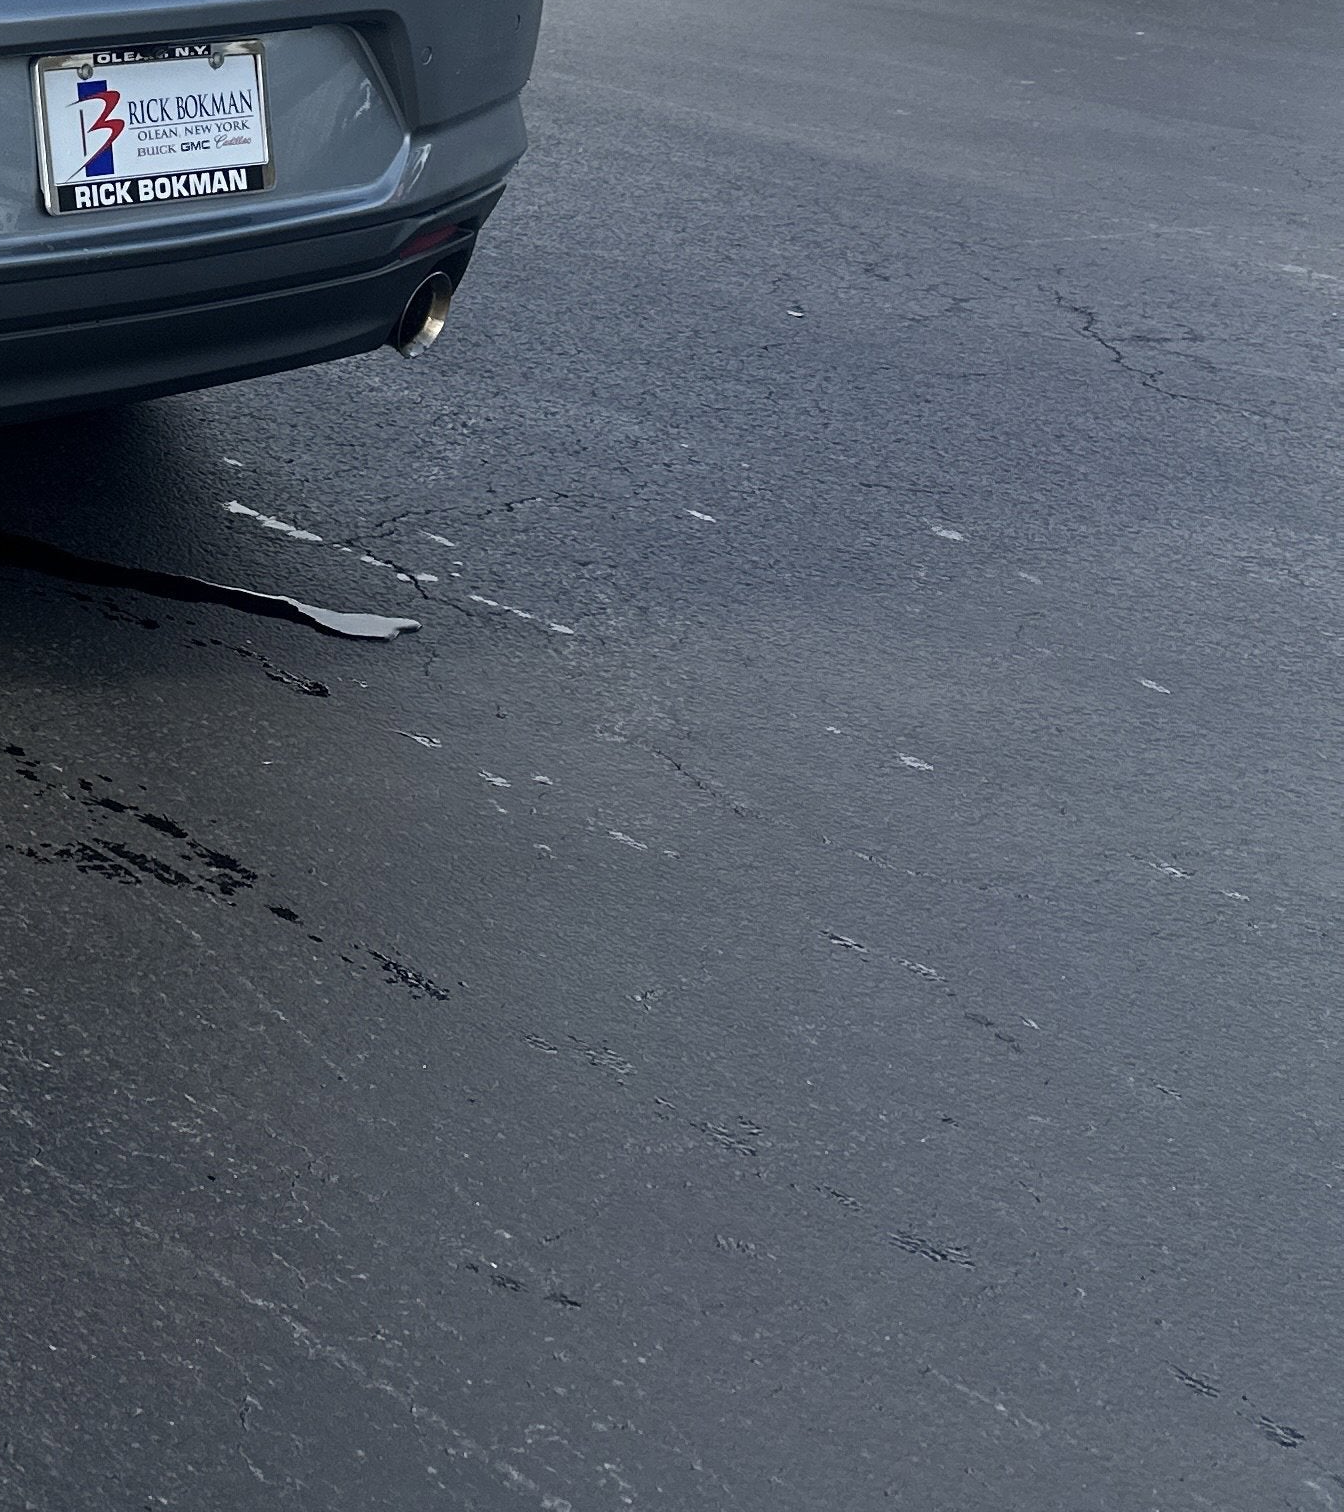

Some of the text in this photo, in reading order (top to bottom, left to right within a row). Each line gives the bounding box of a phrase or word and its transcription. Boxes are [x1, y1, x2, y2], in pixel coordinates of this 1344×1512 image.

[175, 45, 209, 57] N.Y.
[127, 88, 253, 126] RICK BOKMAN
[184, 123, 212, 137] NEW
[215, 119, 250, 133] YORK
[137, 133, 252, 157] BUICK GMC Cadillac
[74, 168, 249, 209] RICK BOKMAN
